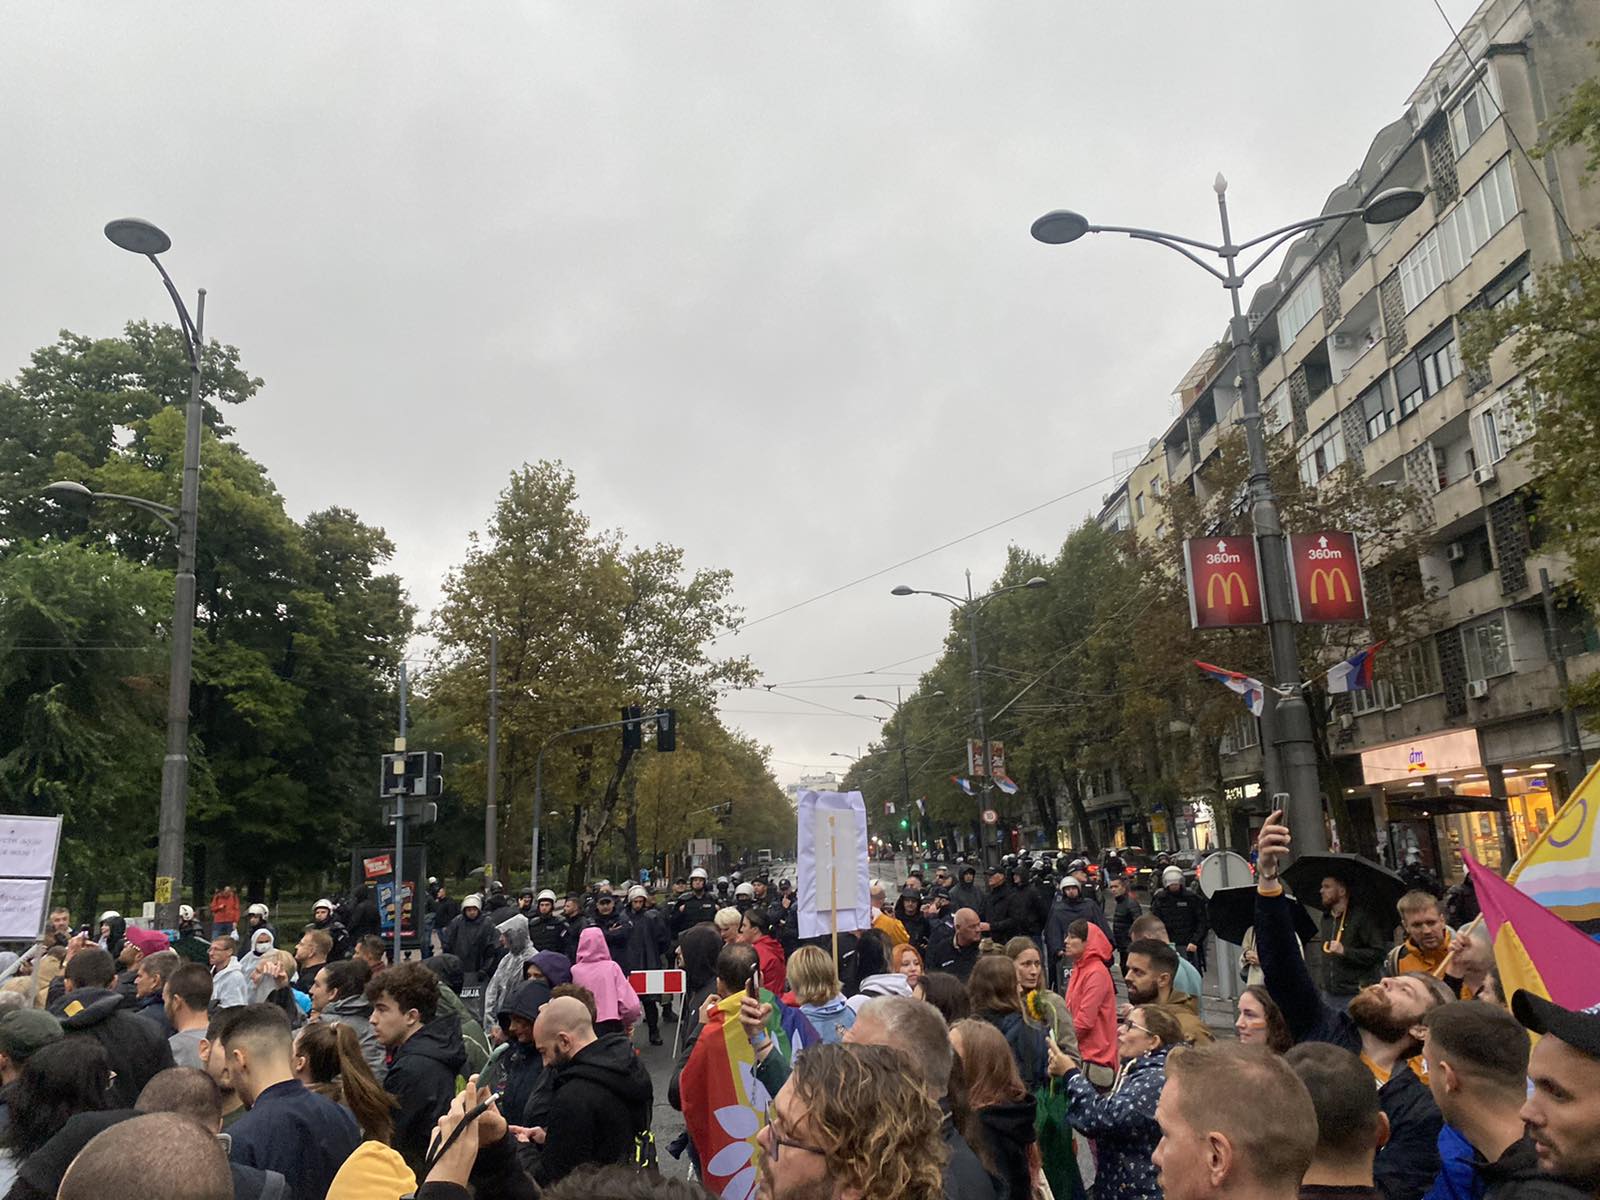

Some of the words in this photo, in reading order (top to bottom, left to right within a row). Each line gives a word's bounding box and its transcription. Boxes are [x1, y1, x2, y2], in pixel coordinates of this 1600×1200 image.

[1207, 553, 1240, 565] 360m
[1308, 549, 1342, 560] 360m
[1409, 747, 1424, 763] dm
